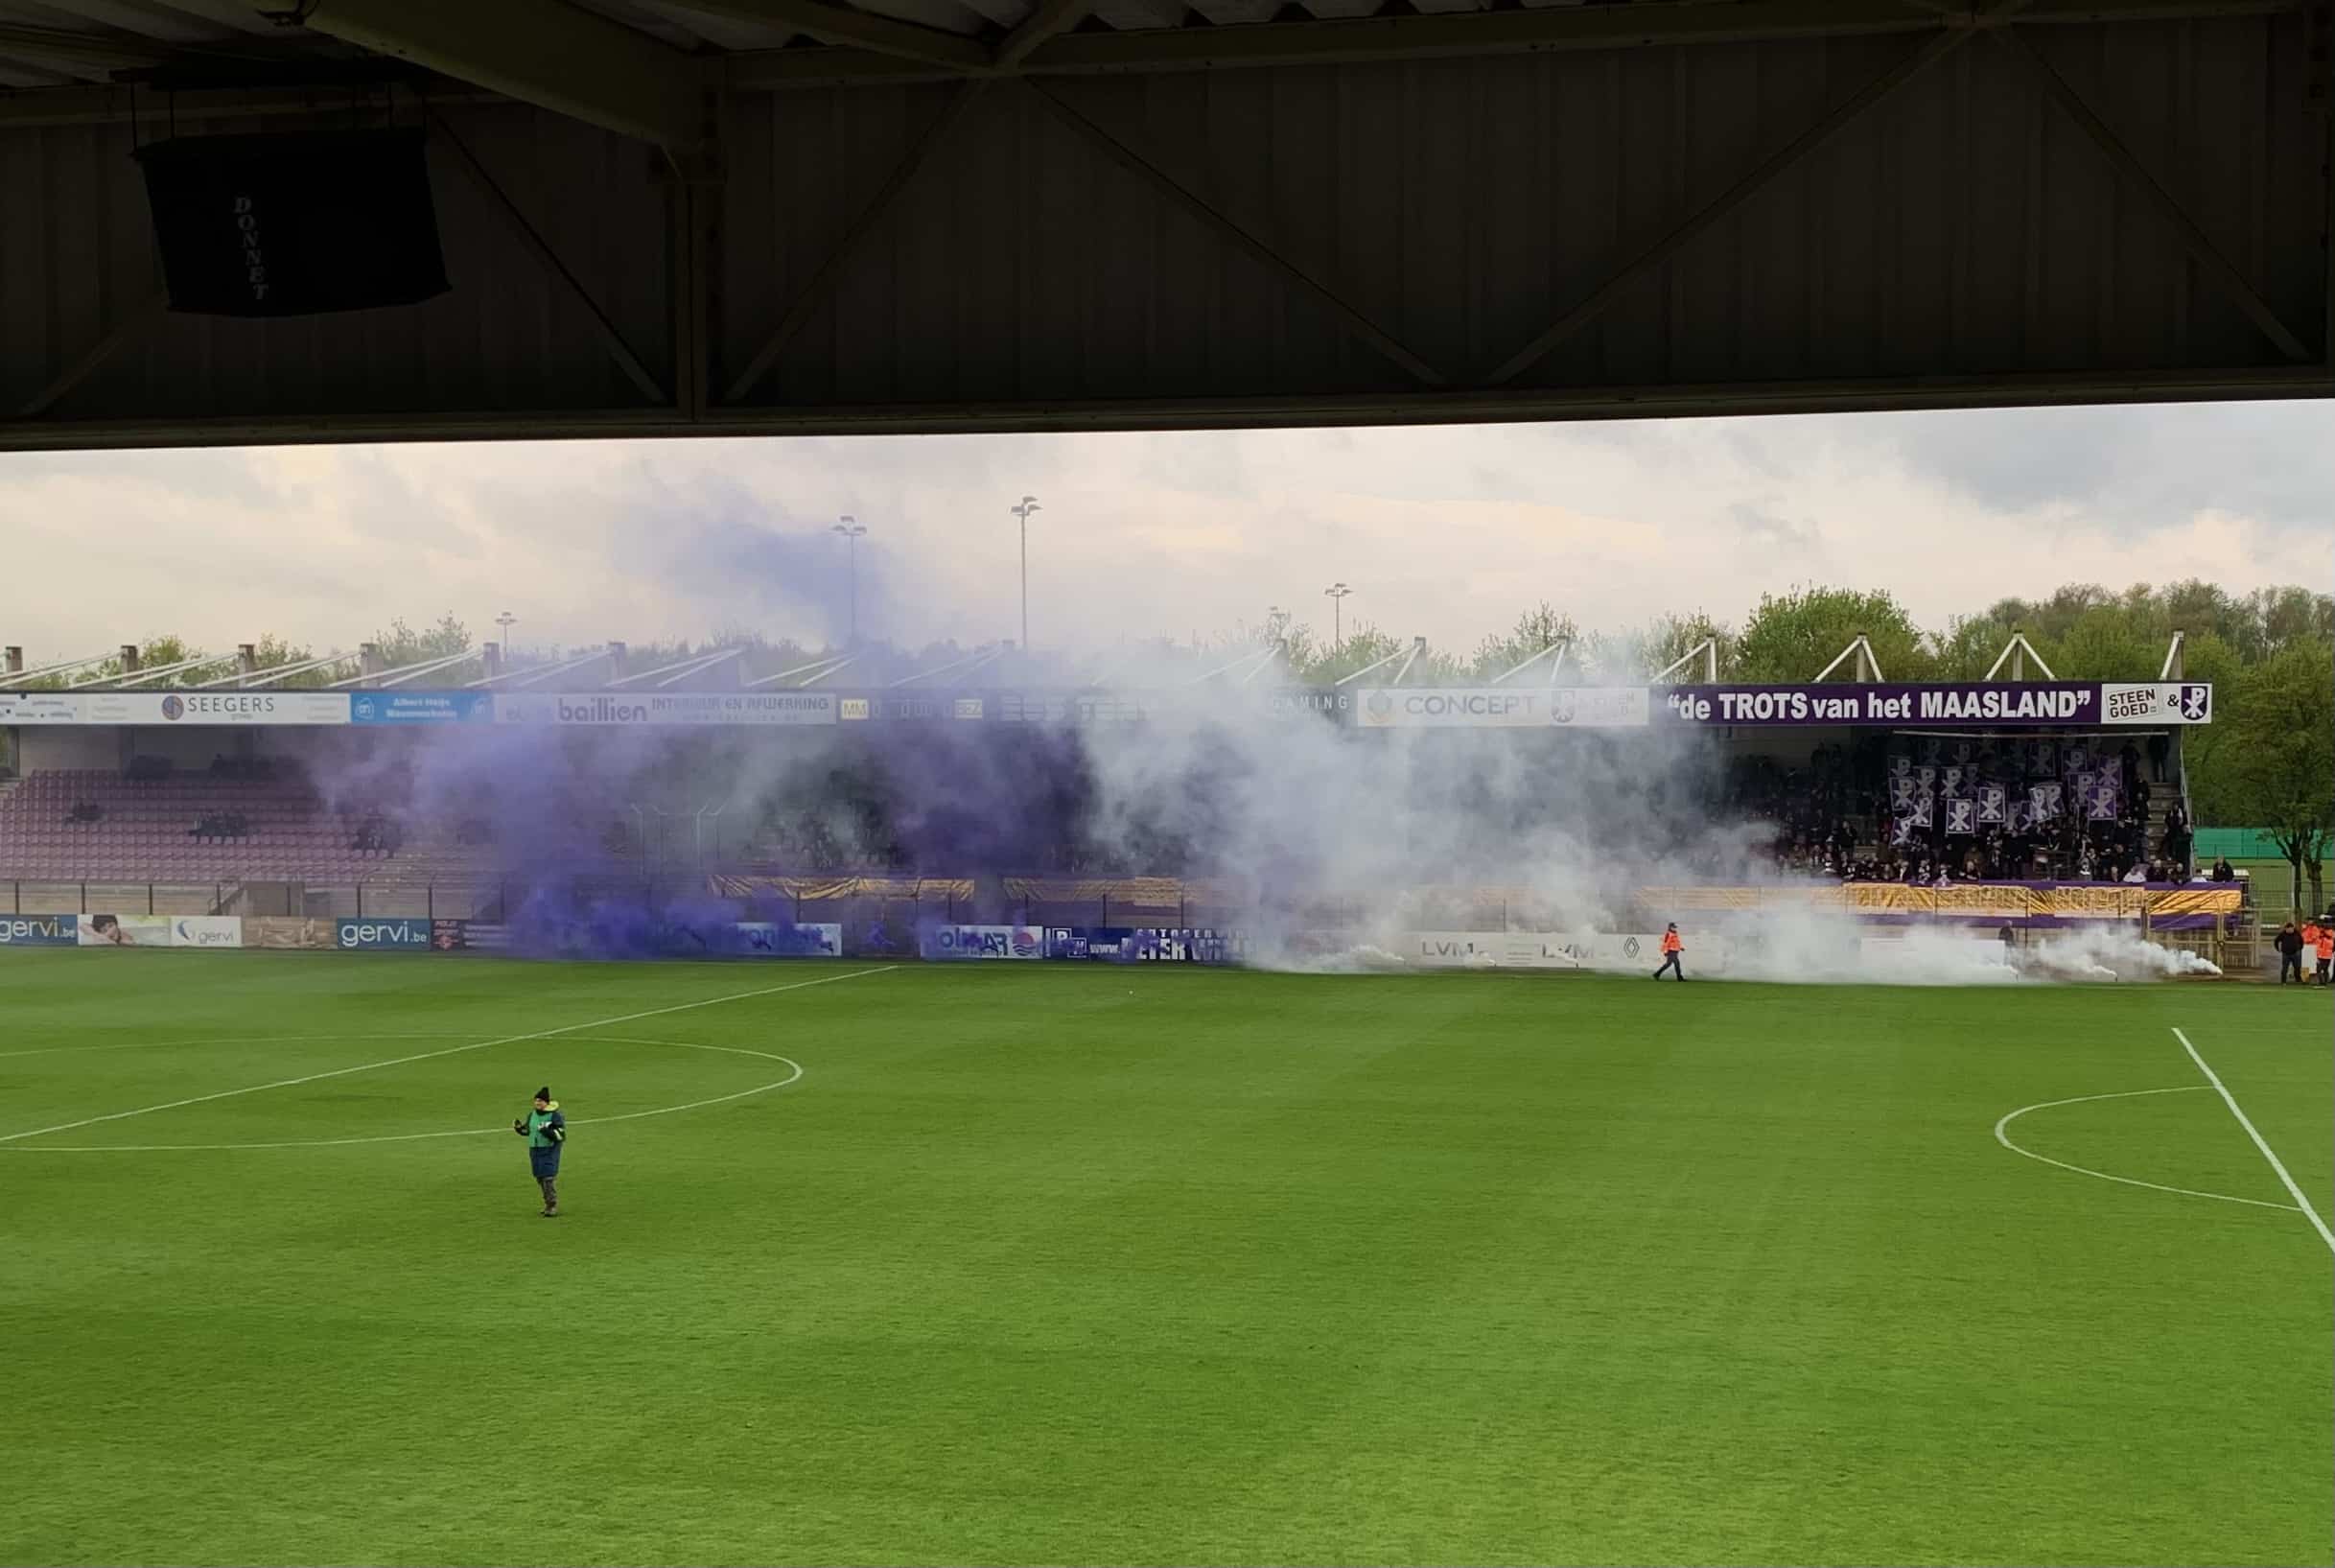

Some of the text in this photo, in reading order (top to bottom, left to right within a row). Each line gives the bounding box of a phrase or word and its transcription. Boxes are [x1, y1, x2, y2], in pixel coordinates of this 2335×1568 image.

[188, 697, 274, 713] SEEGERS
[1405, 695, 1535, 714] CONCEPT
[1718, 691, 1808, 720] TROTS
[1812, 698, 1858, 719] van
[1868, 690, 1911, 719] het
[2109, 688, 2156, 706] STEEN
[559, 698, 647, 722] baillien
[2110, 703, 2148, 718] GOED
[198, 929, 234, 945] gervi
[341, 921, 427, 948] gervi.be
